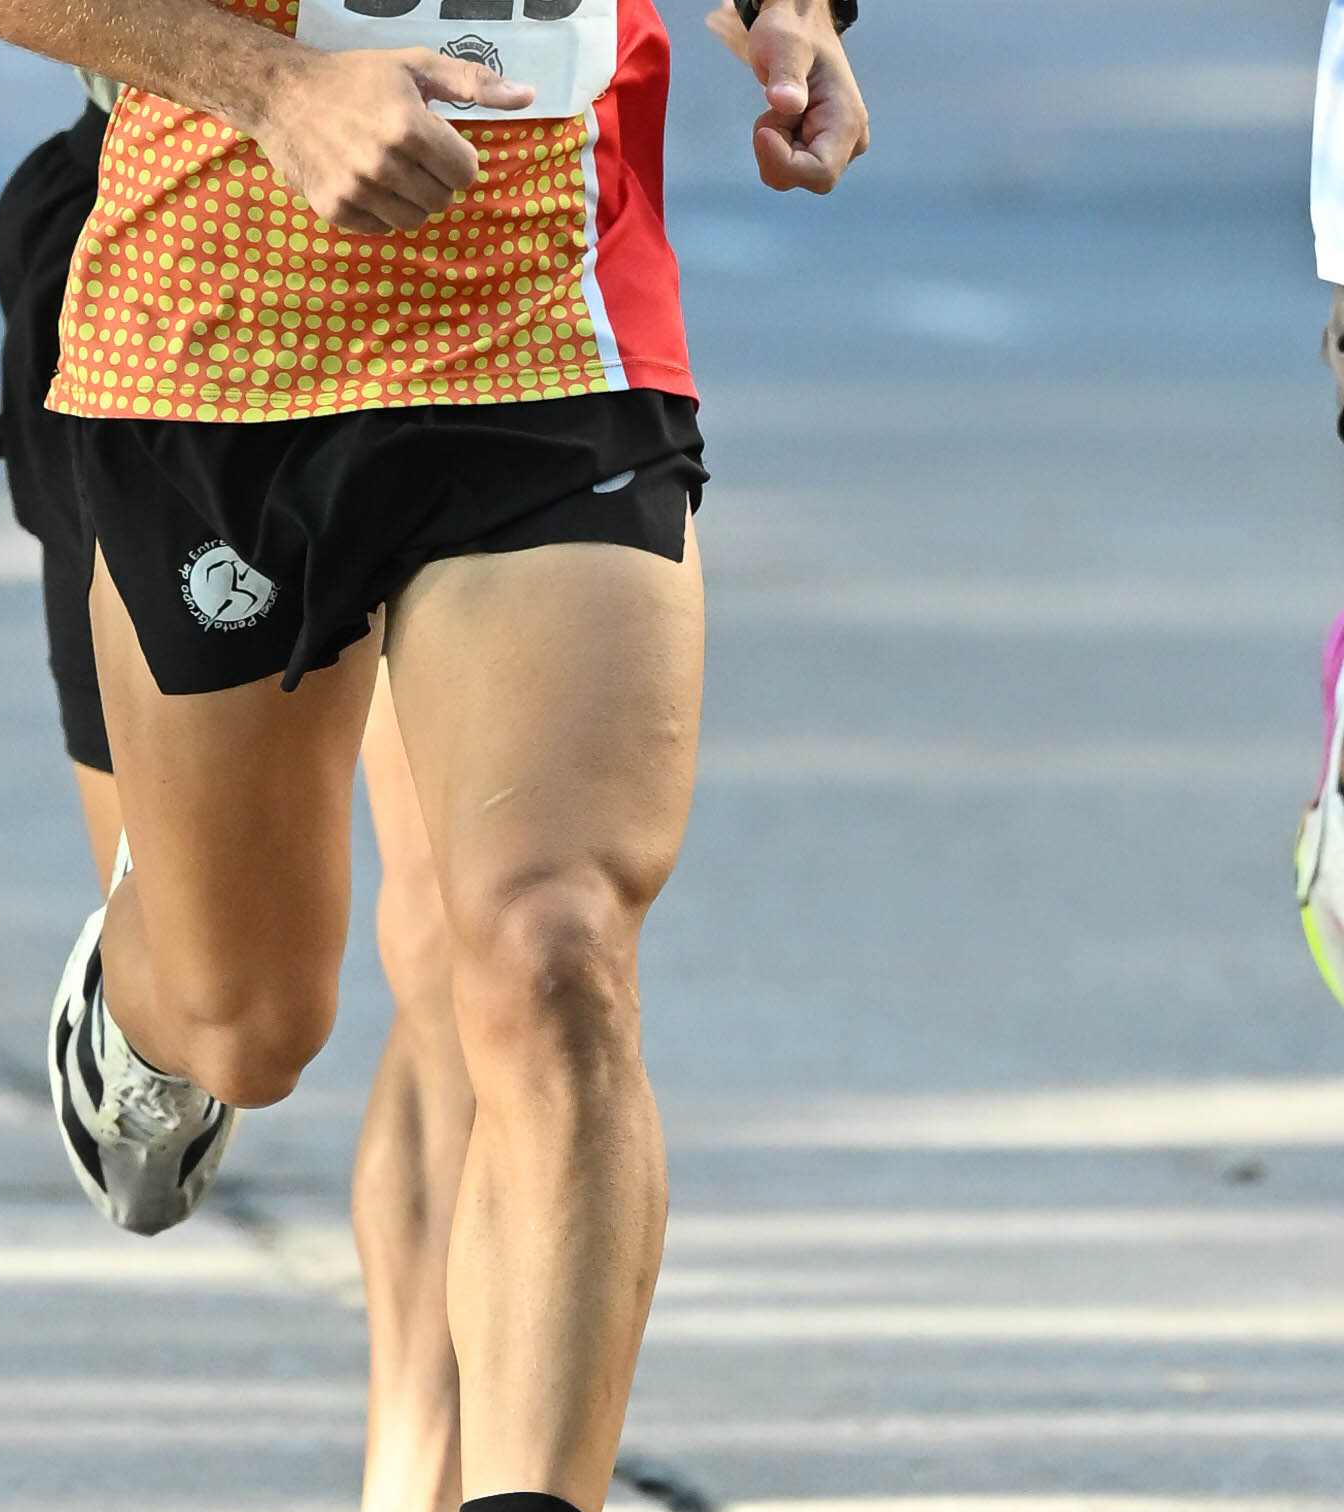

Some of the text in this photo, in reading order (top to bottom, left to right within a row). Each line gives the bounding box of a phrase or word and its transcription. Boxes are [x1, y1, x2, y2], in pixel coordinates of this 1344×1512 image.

[177, 563, 192, 580] de
[180, 584, 209, 625] Grupo
[214, 616, 257, 632] Penta
